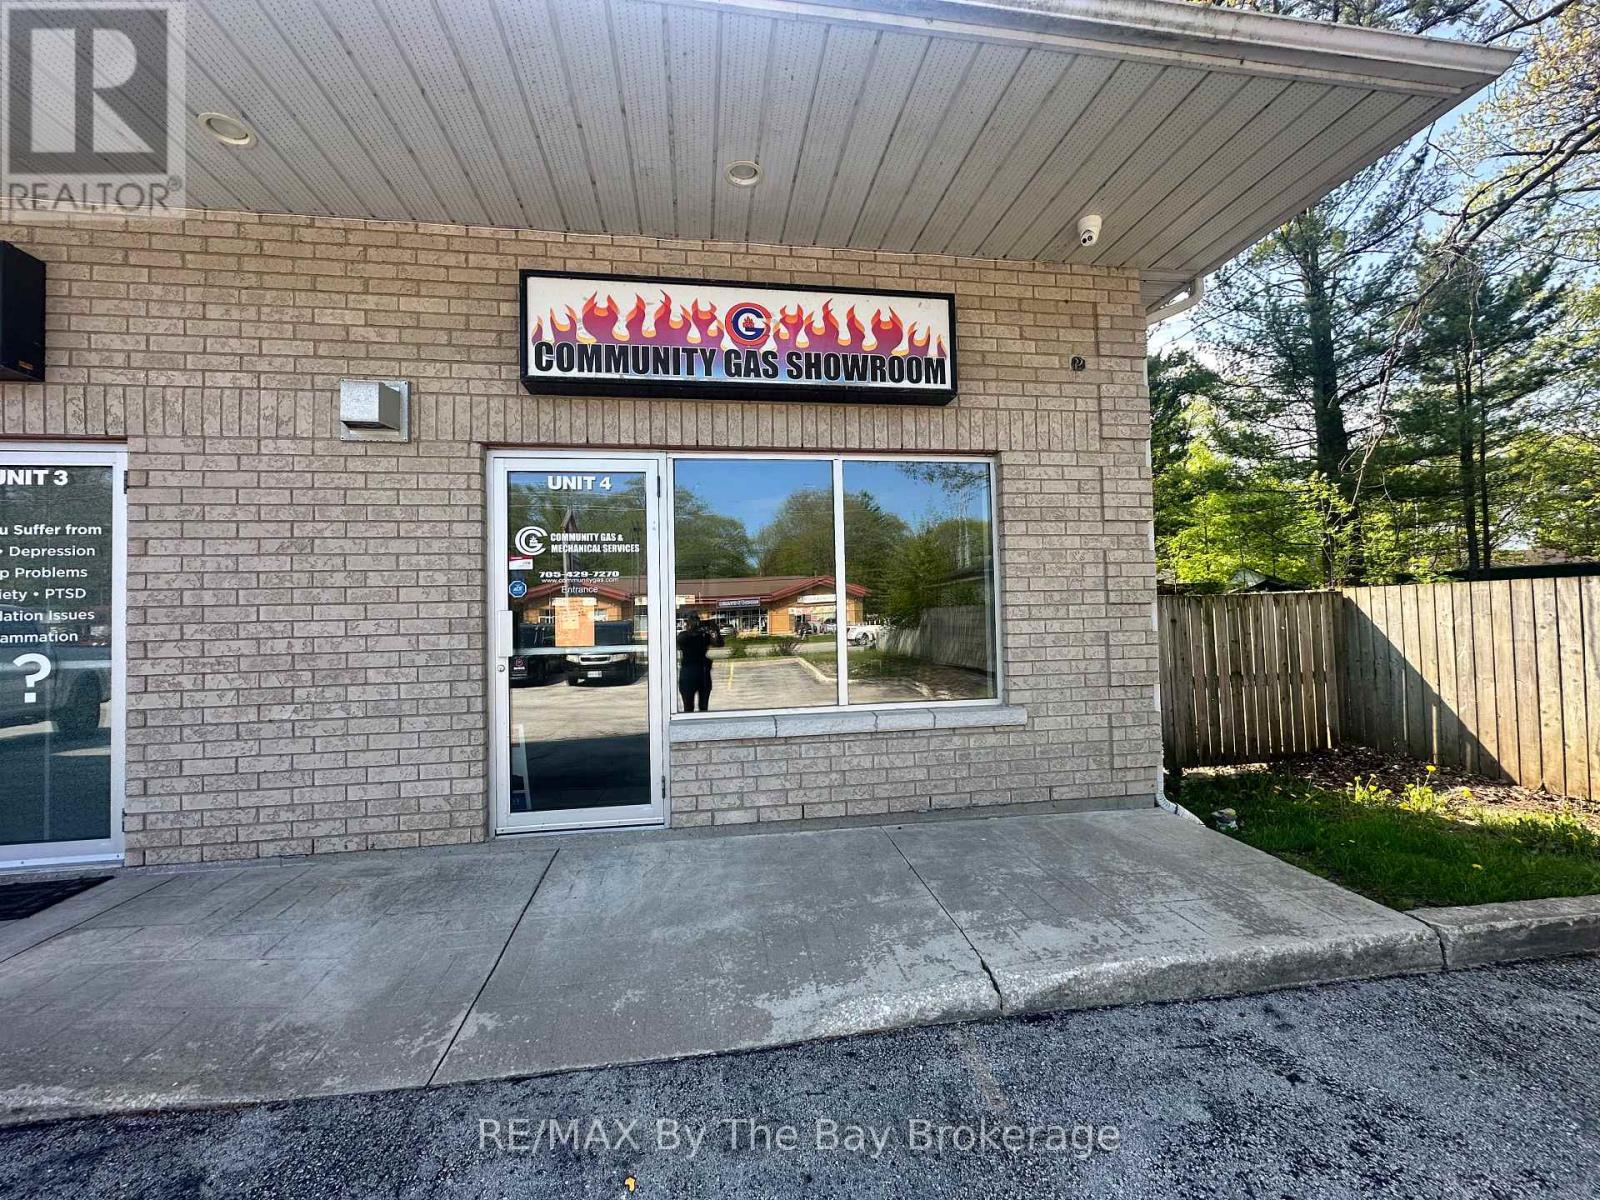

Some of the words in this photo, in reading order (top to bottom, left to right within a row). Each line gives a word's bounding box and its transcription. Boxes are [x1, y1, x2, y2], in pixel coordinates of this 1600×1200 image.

[534, 341, 717, 376] COMMUNITY
[724, 348, 778, 379] GAS
[786, 353, 947, 385] SHOWROOM
[53, 470, 68, 486] 3
[547, 475, 596, 490] UNIT
[599, 476, 612, 490] 4
[13, 523, 61, 535] Suffer
[65, 524, 102, 535] from
[550, 532, 599, 541] COMMUNITY
[600, 533, 617, 541] GAS
[617, 533, 624, 541] &
[9, 546, 96, 557] Depression
[551, 544, 601, 553] MECHANICAL
[602, 543, 640, 553] SERVICES
[15, 566, 88, 578] Problems
[45, 588, 87, 599] PTSD
[561, 585, 598, 594] Entrance
[49, 609, 95, 620] Issues
[13, 652, 51, 703] ?
